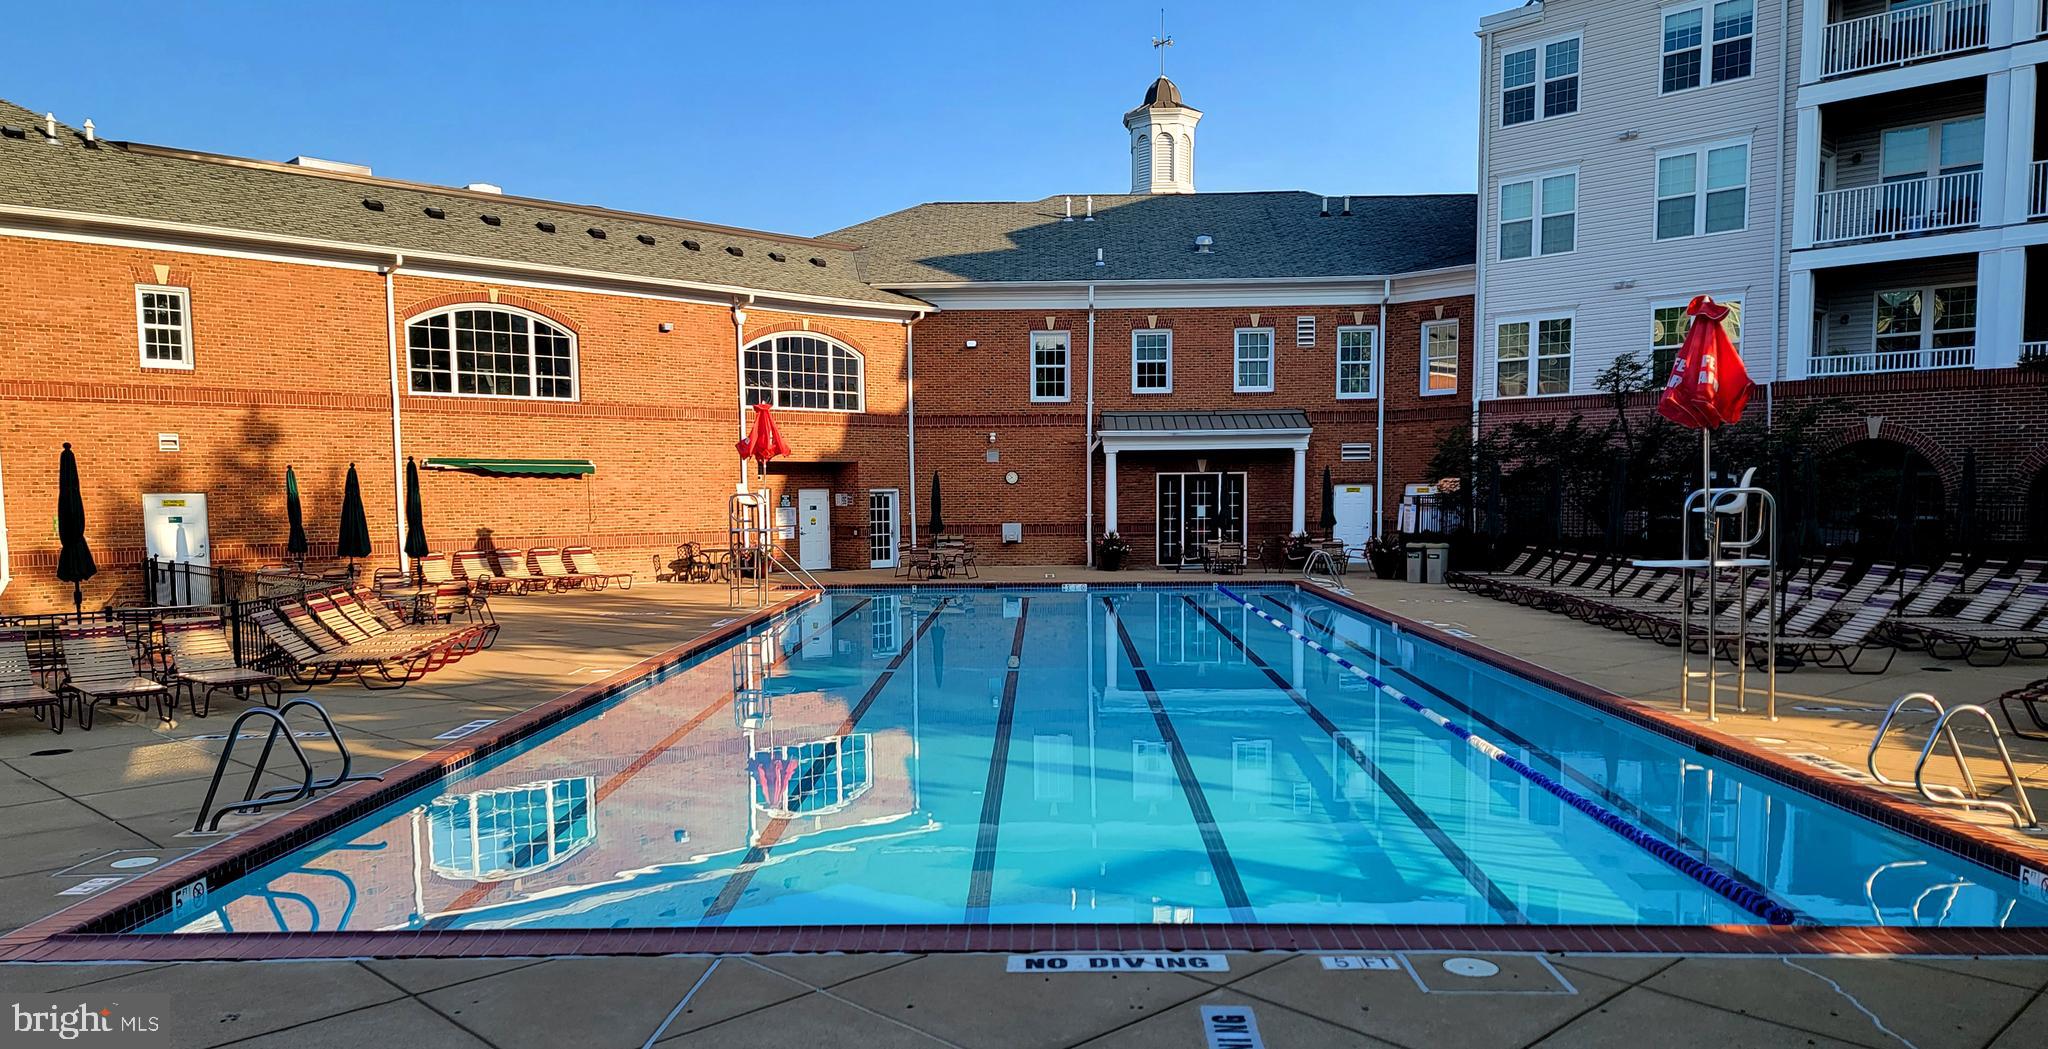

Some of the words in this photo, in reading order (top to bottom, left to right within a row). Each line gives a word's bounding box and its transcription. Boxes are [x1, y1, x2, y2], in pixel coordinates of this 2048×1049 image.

[175, 890, 183, 909] 5
[1025, 958, 1068, 969] NO
[1089, 957, 1210, 969] DIVING
[1334, 957, 1350, 968] 5
[1361, 957, 1391, 968] FT
